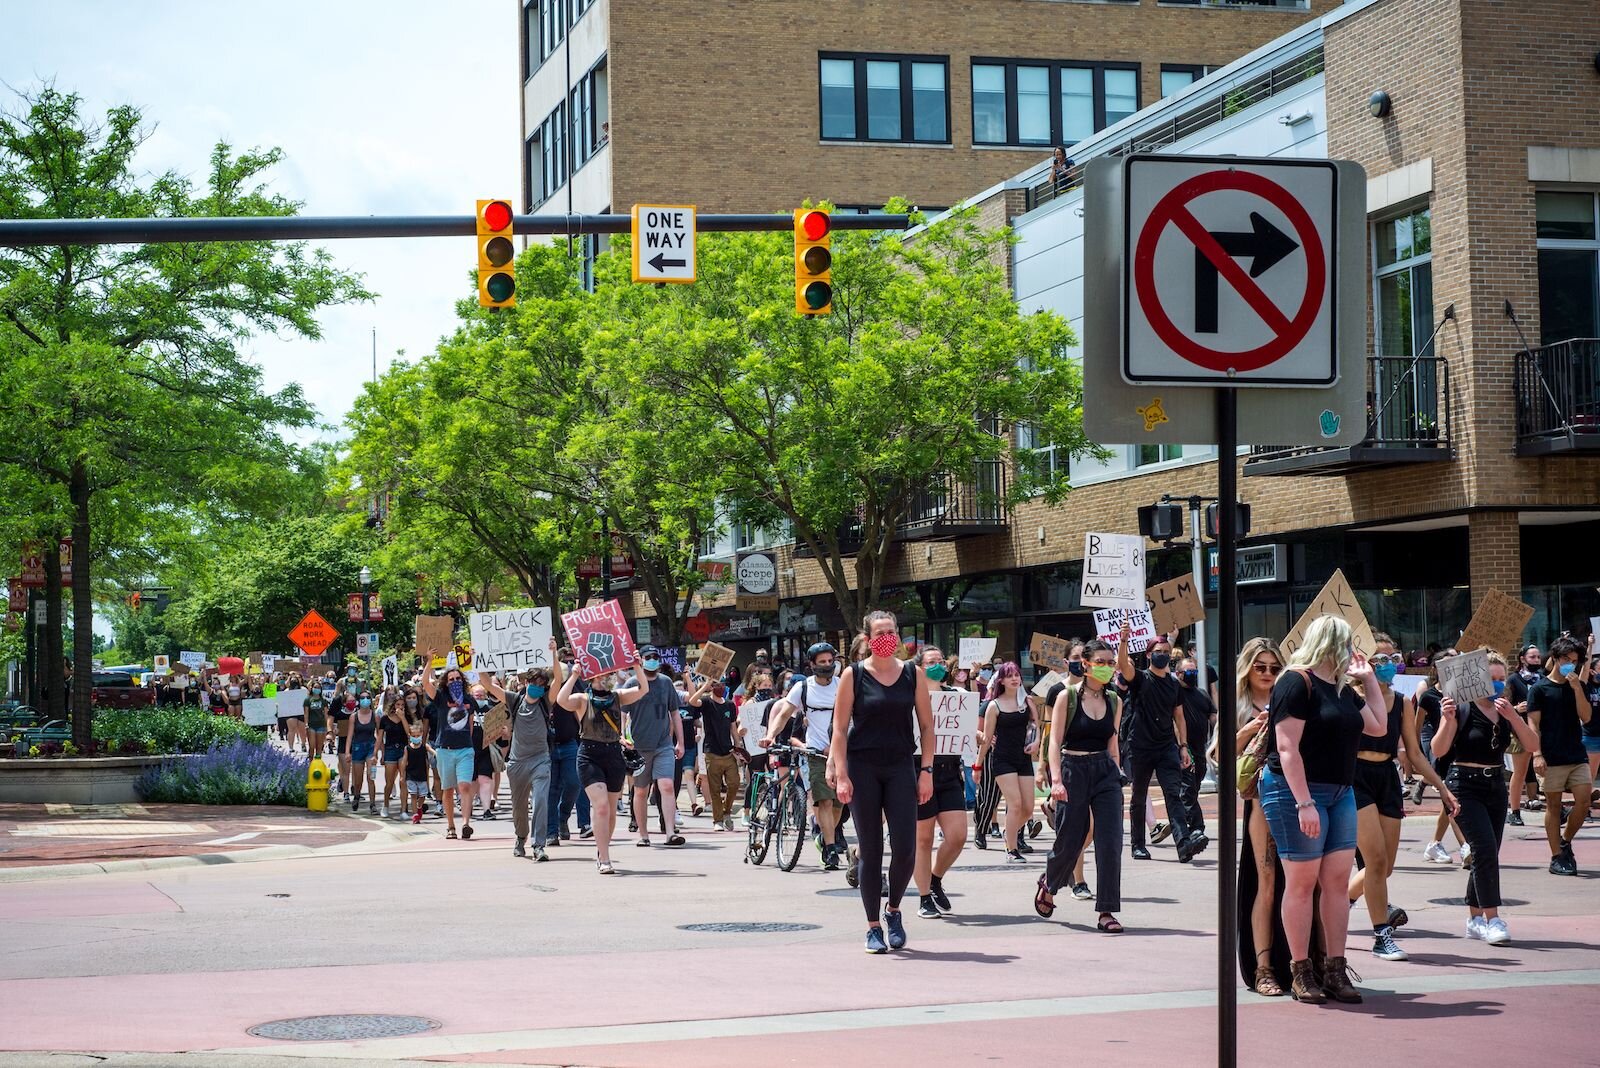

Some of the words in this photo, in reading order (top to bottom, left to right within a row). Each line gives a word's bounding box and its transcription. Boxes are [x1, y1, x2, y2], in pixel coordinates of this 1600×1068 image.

[647, 212, 684, 228] ONE
[646, 232, 686, 248] WAY
[741, 569, 772, 580] Crepe
[1085, 582, 1135, 597] MURDER
[481, 611, 544, 632] BLACK
[562, 600, 618, 628] PROTECT
[1096, 608, 1125, 622] BLACK
[1108, 614, 1150, 632] MTER
[487, 631, 533, 652] LIVES
[612, 617, 634, 664] LIVES
[475, 648, 547, 669] MATTER
[567, 628, 594, 677] BLACK
[658, 656, 678, 664] IVES
[1444, 656, 1486, 681] BLACK
[1455, 672, 1481, 689] LIVES
[929, 694, 968, 712] ACK
[932, 715, 960, 729] IVES
[932, 734, 973, 753] TTER
